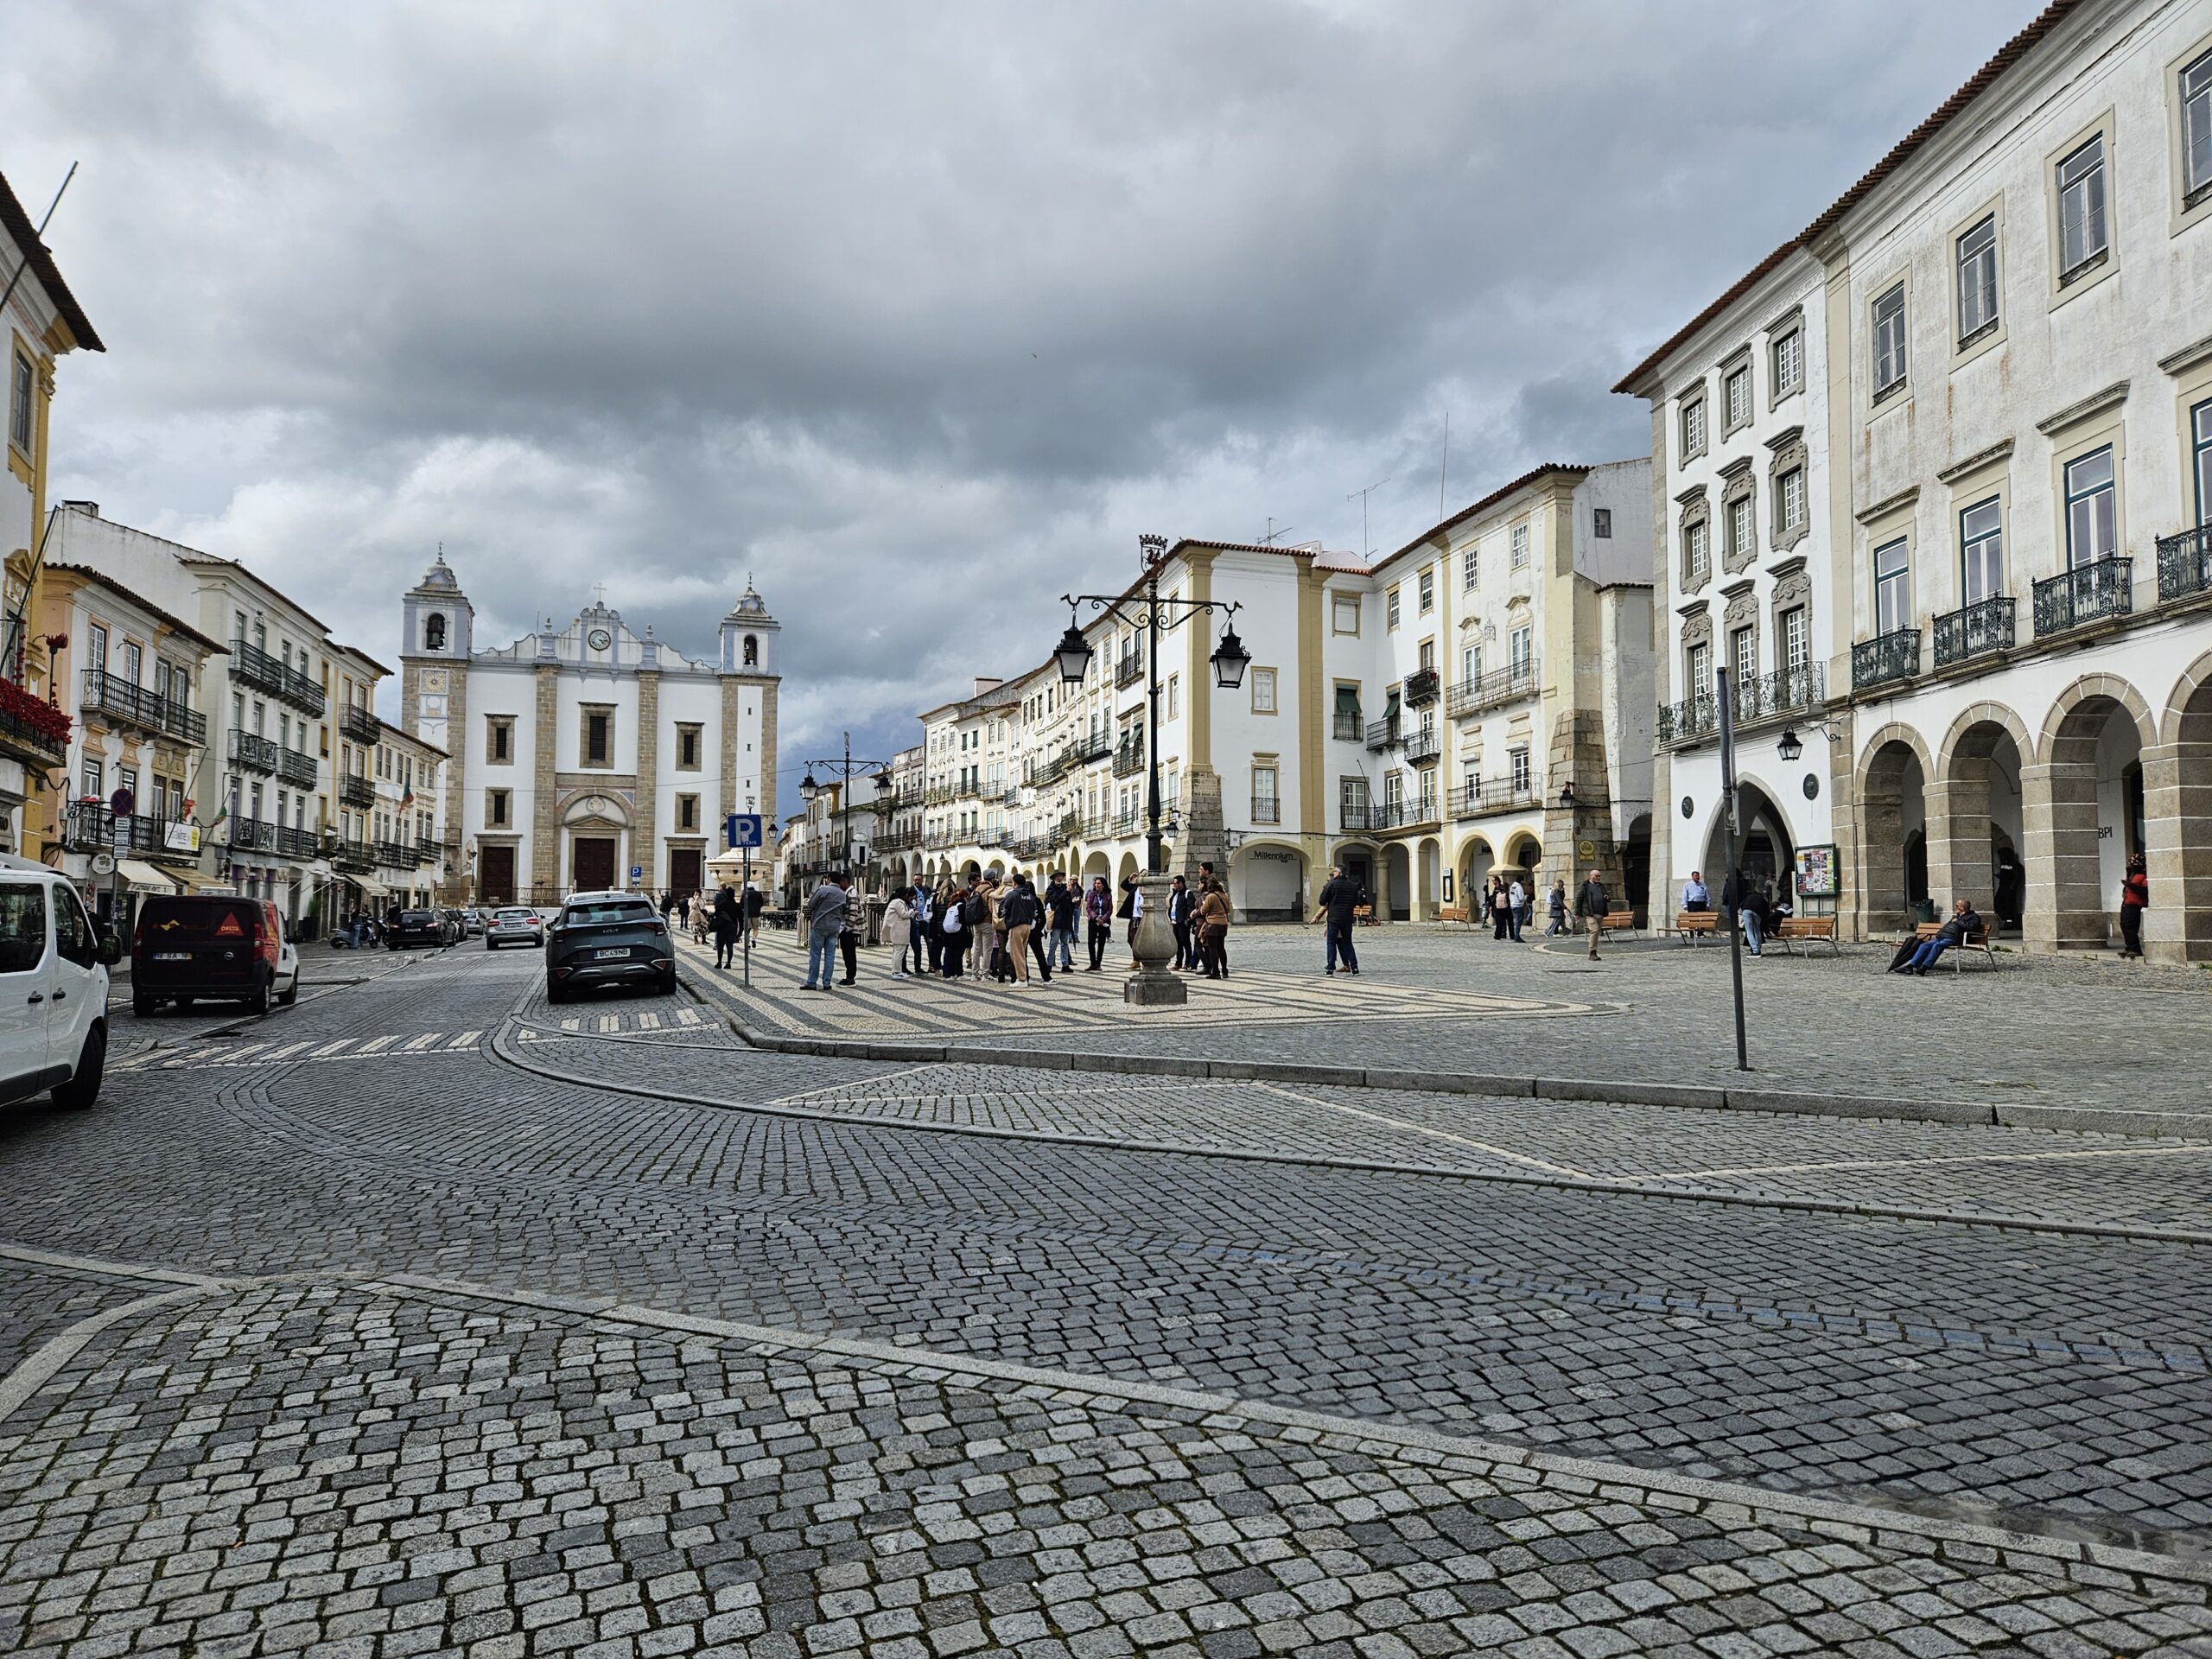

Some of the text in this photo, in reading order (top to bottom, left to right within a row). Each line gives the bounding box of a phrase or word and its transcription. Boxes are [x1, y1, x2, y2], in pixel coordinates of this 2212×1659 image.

[735, 818, 755, 845] P
[2098, 826, 2113, 838] BPI
[1254, 850, 1294, 860] Millennium
[632, 868, 639, 876] P
